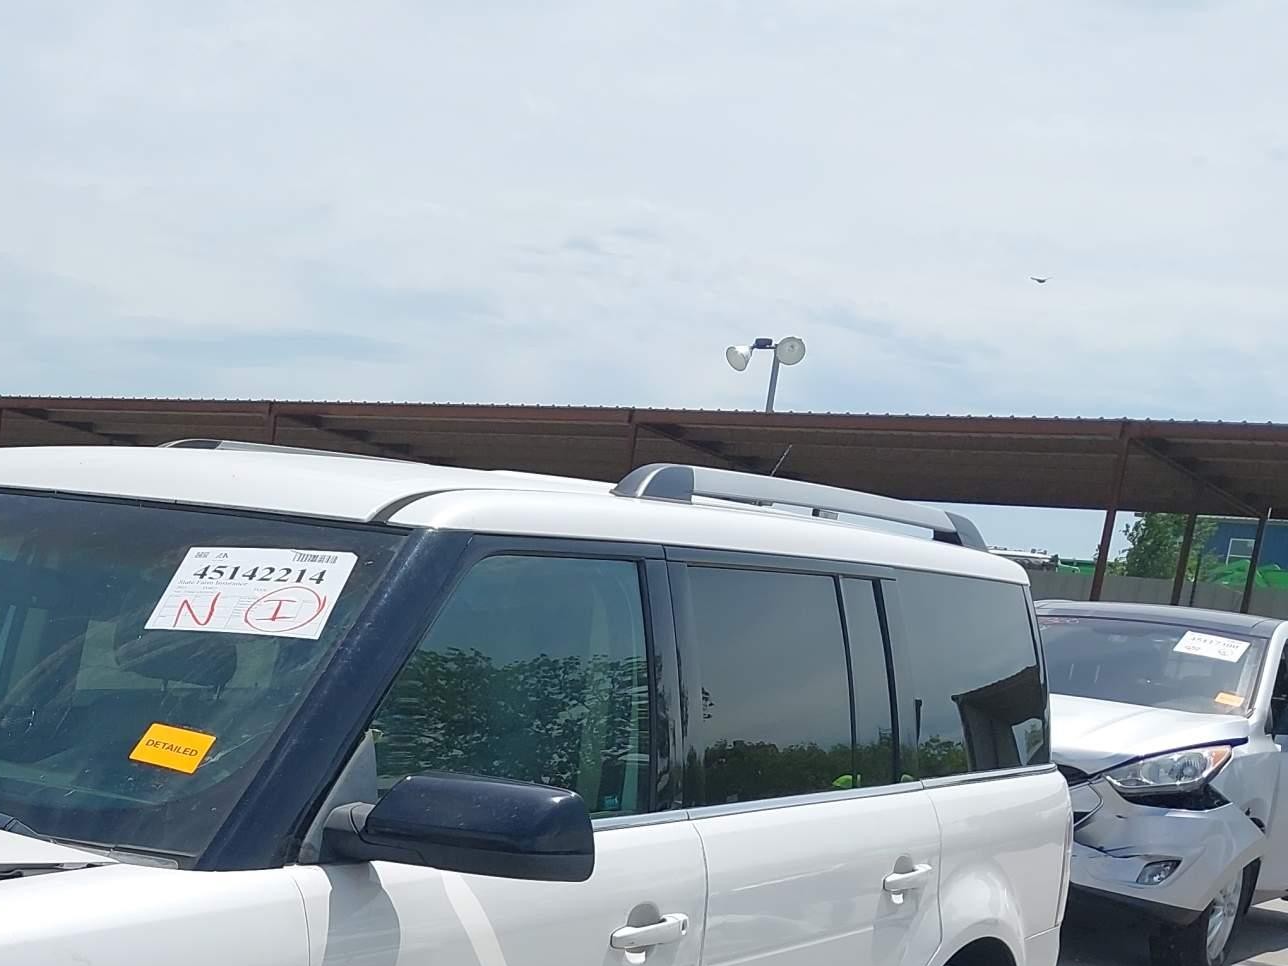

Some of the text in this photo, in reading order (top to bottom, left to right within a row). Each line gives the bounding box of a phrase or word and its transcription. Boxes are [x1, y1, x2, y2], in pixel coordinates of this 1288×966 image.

[193, 564, 327, 585] 45142214
[173, 592, 221, 628] N
[145, 738, 199, 757] DETAILED
